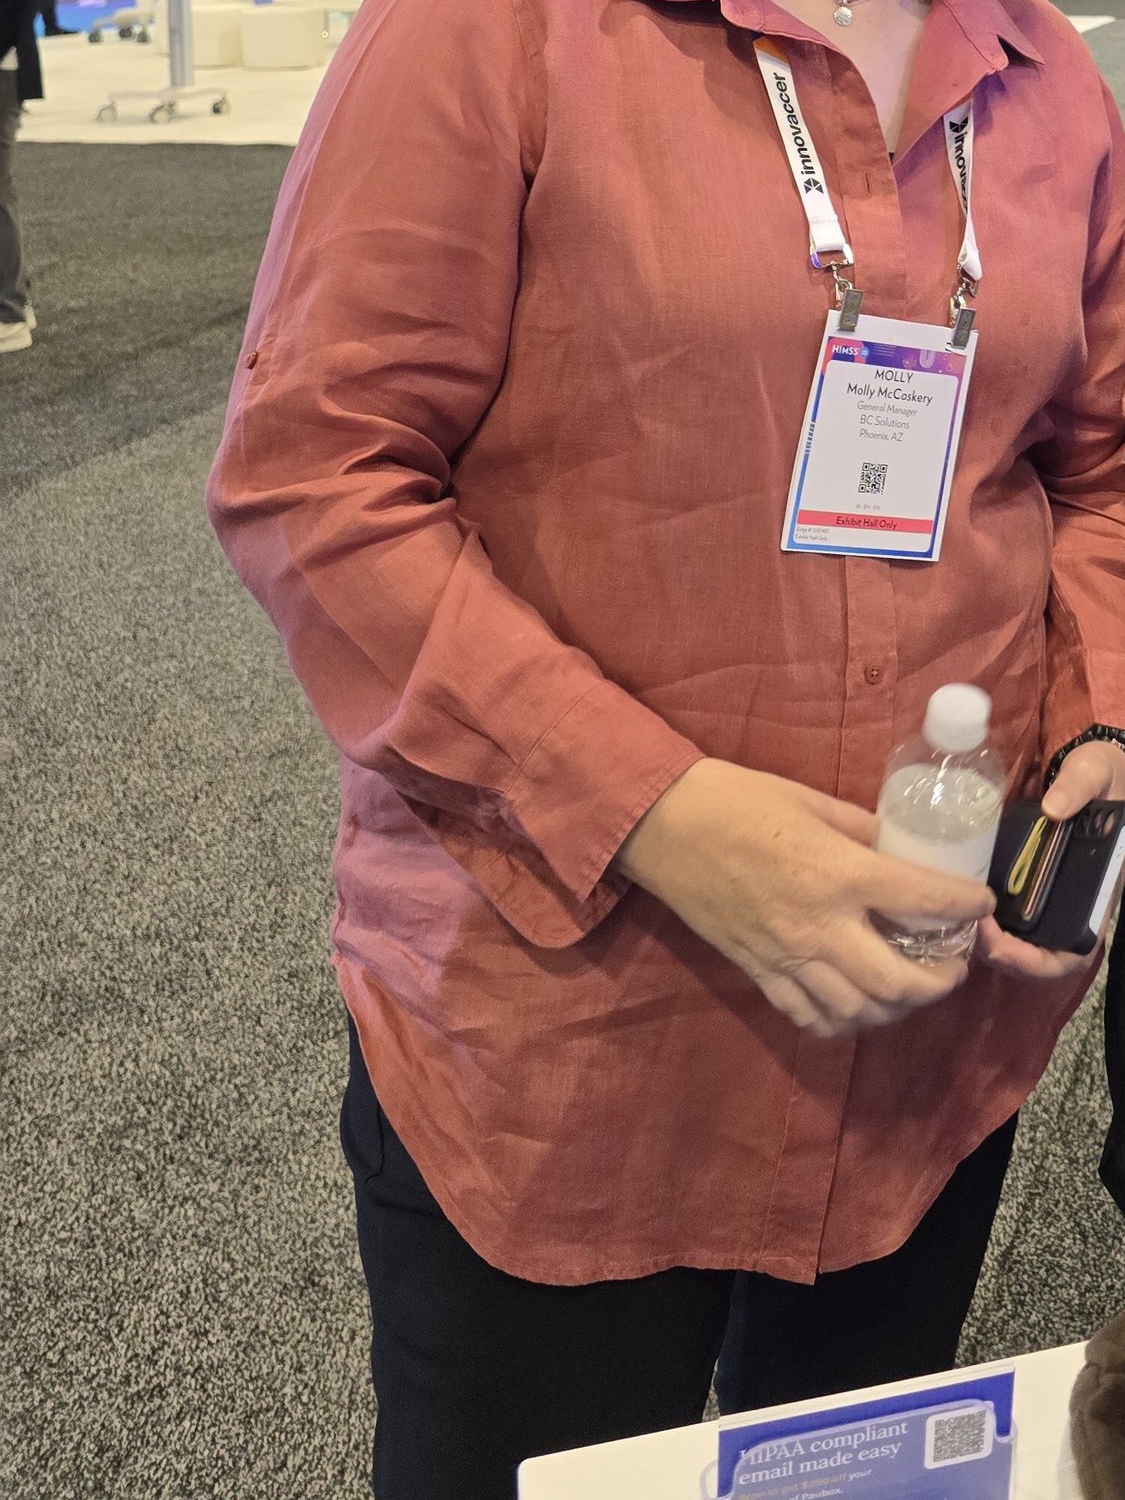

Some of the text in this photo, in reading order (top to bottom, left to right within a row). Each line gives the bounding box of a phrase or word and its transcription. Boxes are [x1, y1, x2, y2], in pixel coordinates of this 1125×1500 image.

[772, 71, 816, 176] innovaccer
[874, 369, 914, 384] MOLLY
[846, 382, 934, 407] Molly McCoskery
[856, 400, 919, 418] General Manager
[859, 414, 910, 430] BC Solutions
[890, 431, 904, 443] AZ
[836, 515, 898, 531] Exhibit Hall Only
[810, 1421, 909, 1453] compliant
[738, 1442, 902, 1485] email made easy
[847, 1469, 873, 1483] your
